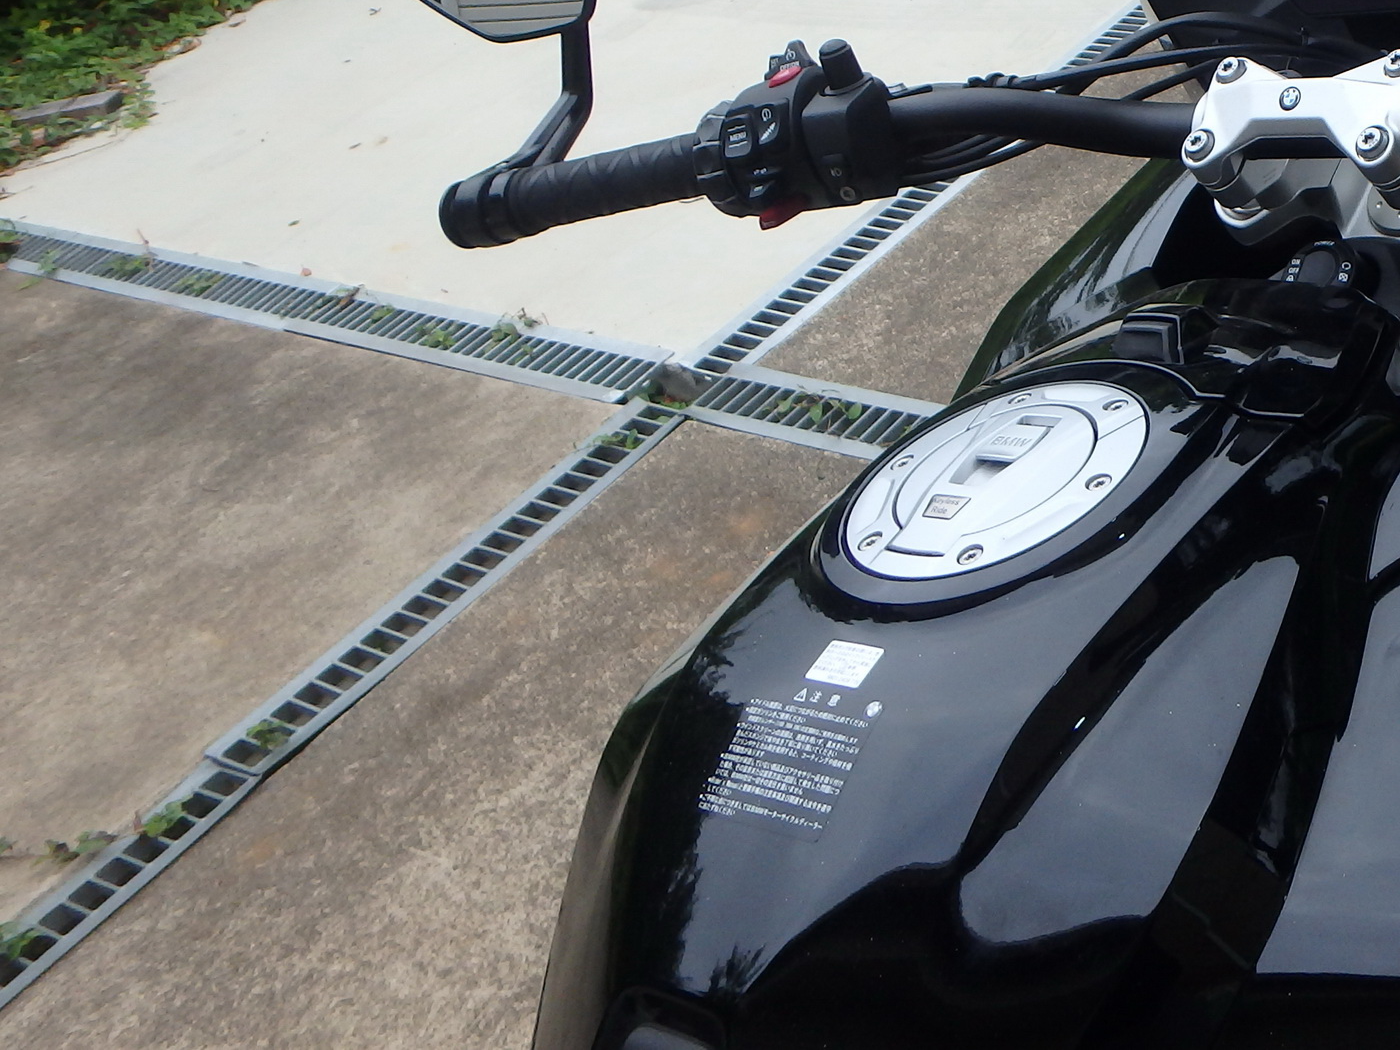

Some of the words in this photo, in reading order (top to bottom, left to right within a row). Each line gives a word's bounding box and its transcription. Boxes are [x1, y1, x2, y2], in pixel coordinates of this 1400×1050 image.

[729, 132, 747, 141] MENU
[990, 435, 1032, 448] BMW
[930, 506, 948, 515] Ride
